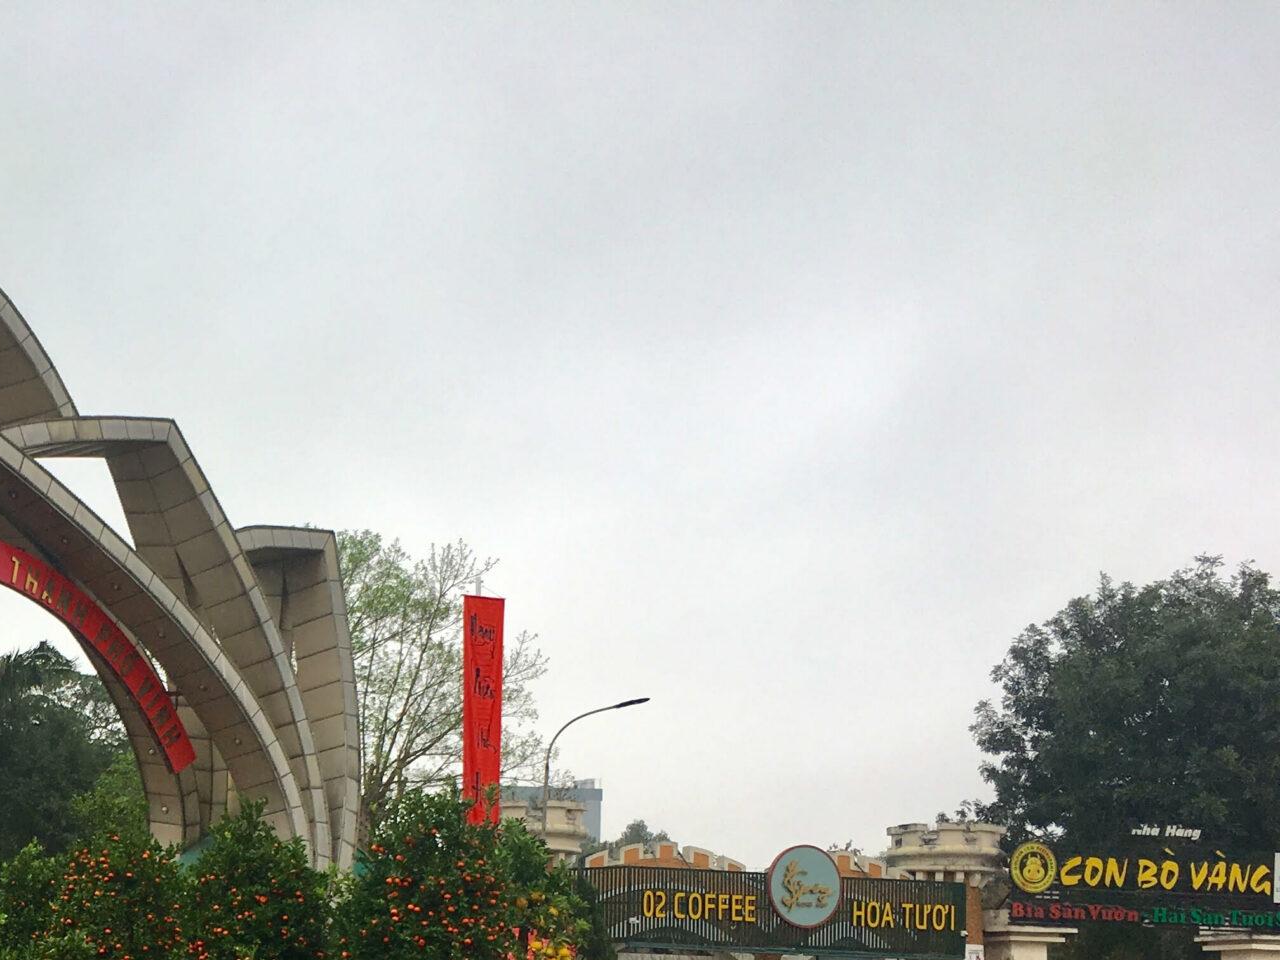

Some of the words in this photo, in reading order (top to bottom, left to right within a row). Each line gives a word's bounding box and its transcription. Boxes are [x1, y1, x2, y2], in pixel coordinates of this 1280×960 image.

[1060, 856, 1128, 888] CON
[1138, 847, 1179, 890] BÒ
[1190, 850, 1271, 896] VÀNG
[643, 890, 666, 918] 02
[674, 892, 756, 922] COFFEE
[901, 903, 955, 931] TƯƠI
